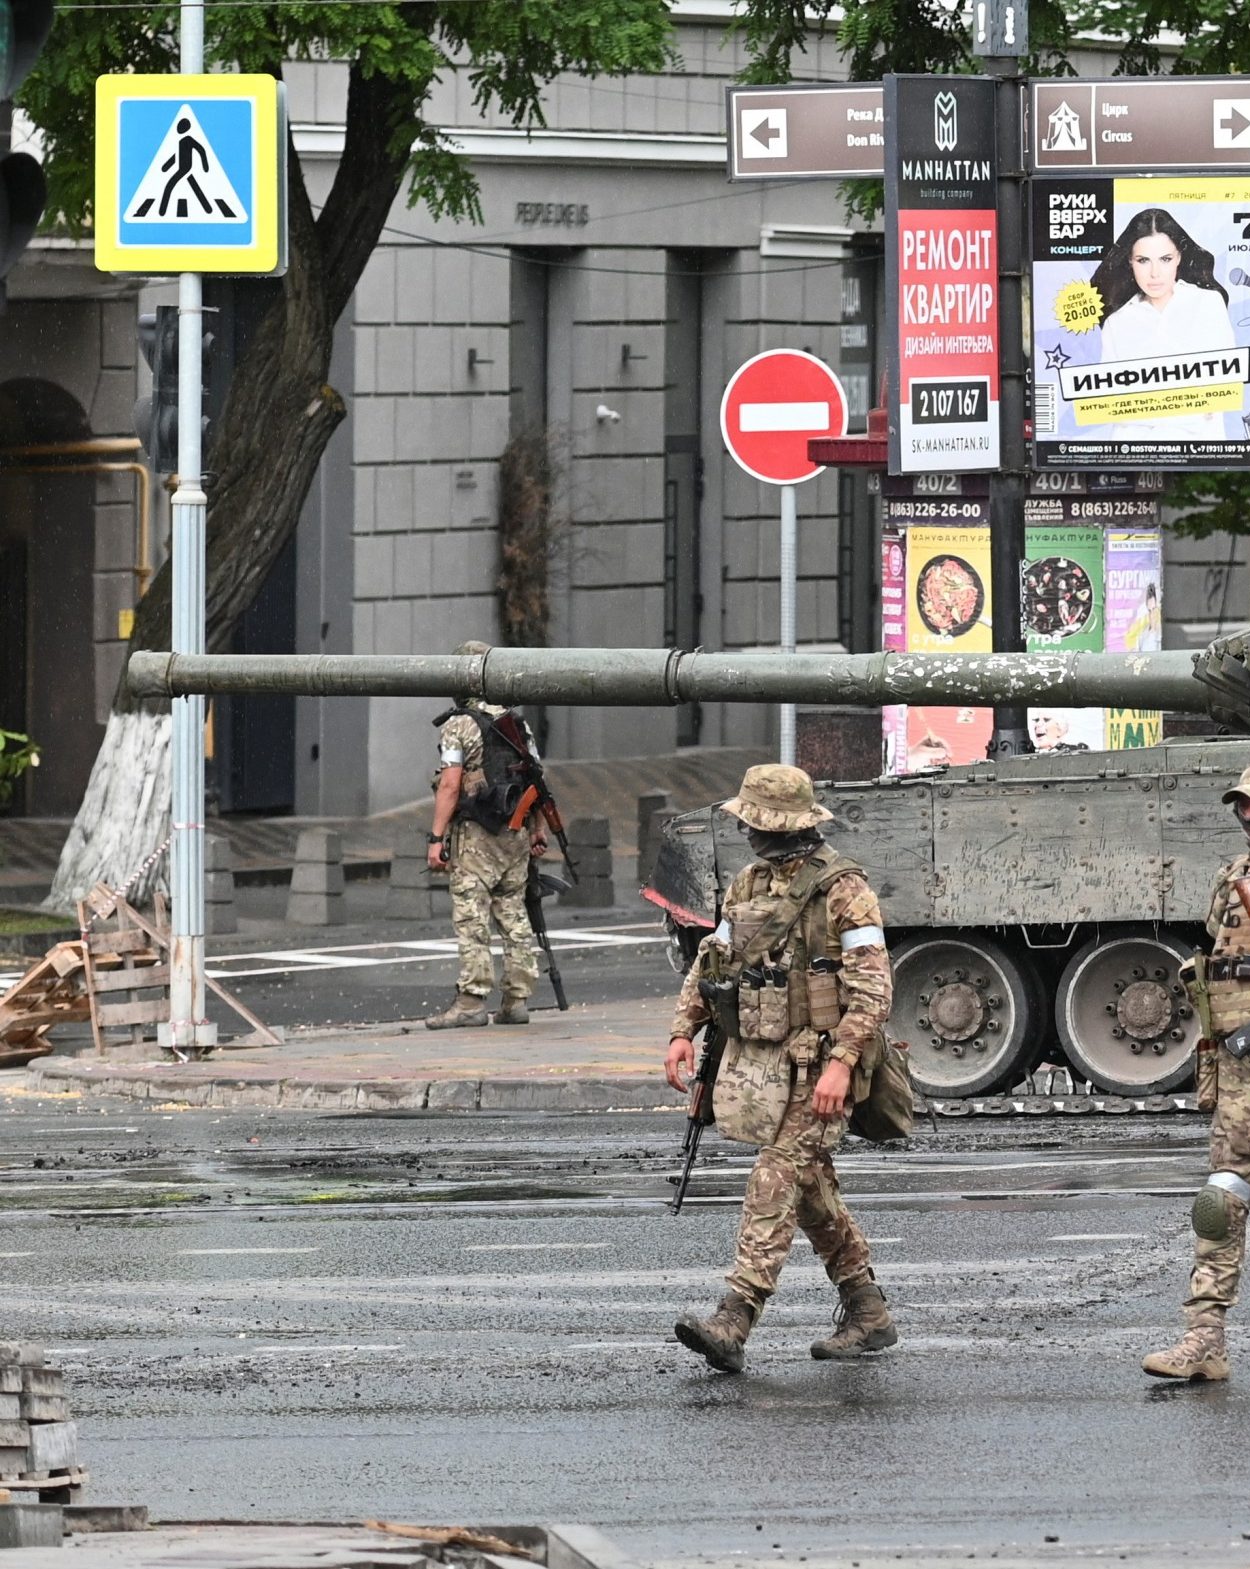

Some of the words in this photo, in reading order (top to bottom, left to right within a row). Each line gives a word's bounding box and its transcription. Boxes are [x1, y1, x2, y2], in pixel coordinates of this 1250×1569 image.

[847, 108, 873, 121] Река
[1101, 103, 1128, 117] Цирк
[847, 134, 868, 147] Don
[869, 133, 884, 146] Riv
[1101, 130, 1133, 143] Circus
[902, 160, 991, 181] MANHATTAN
[920, 188, 945, 200] building
[946, 189, 974, 200] company
[1049, 193, 1096, 209] РУКИ
[1168, 192, 1207, 200] ПЯТНИЦА
[1049, 209, 1107, 224] ВВЕРХ
[1049, 225, 1084, 239] БАР
[903, 229, 992, 271] РЕМОНТ
[1050, 246, 1104, 255] КОНЦЕРТ
[903, 283, 993, 324] КВАРТИР
[1068, 292, 1085, 302] СБОР
[1063, 299, 1087, 311] ГОСТЕЙ
[1064, 305, 1097, 323] 20:00
[905, 332, 944, 358] ДИЗАЙН
[945, 335, 993, 354] ИНТЕРЬЕРА
[1073, 357, 1241, 392] ИНФИНИТИ
[920, 392, 929, 417] 2
[931, 390, 954, 417] 107
[957, 389, 980, 416] 167
[912, 436, 990, 453] SK-MANHATTAN.RU
[1068, 445, 1103, 453] СЕМАШКО
[917, 474, 957, 492] 40/2
[1035, 473, 1082, 491] 40/1
[1024, 500, 1062, 508] ЛУЖБА
[1026, 534, 1098, 542] НУФАКТУРА
